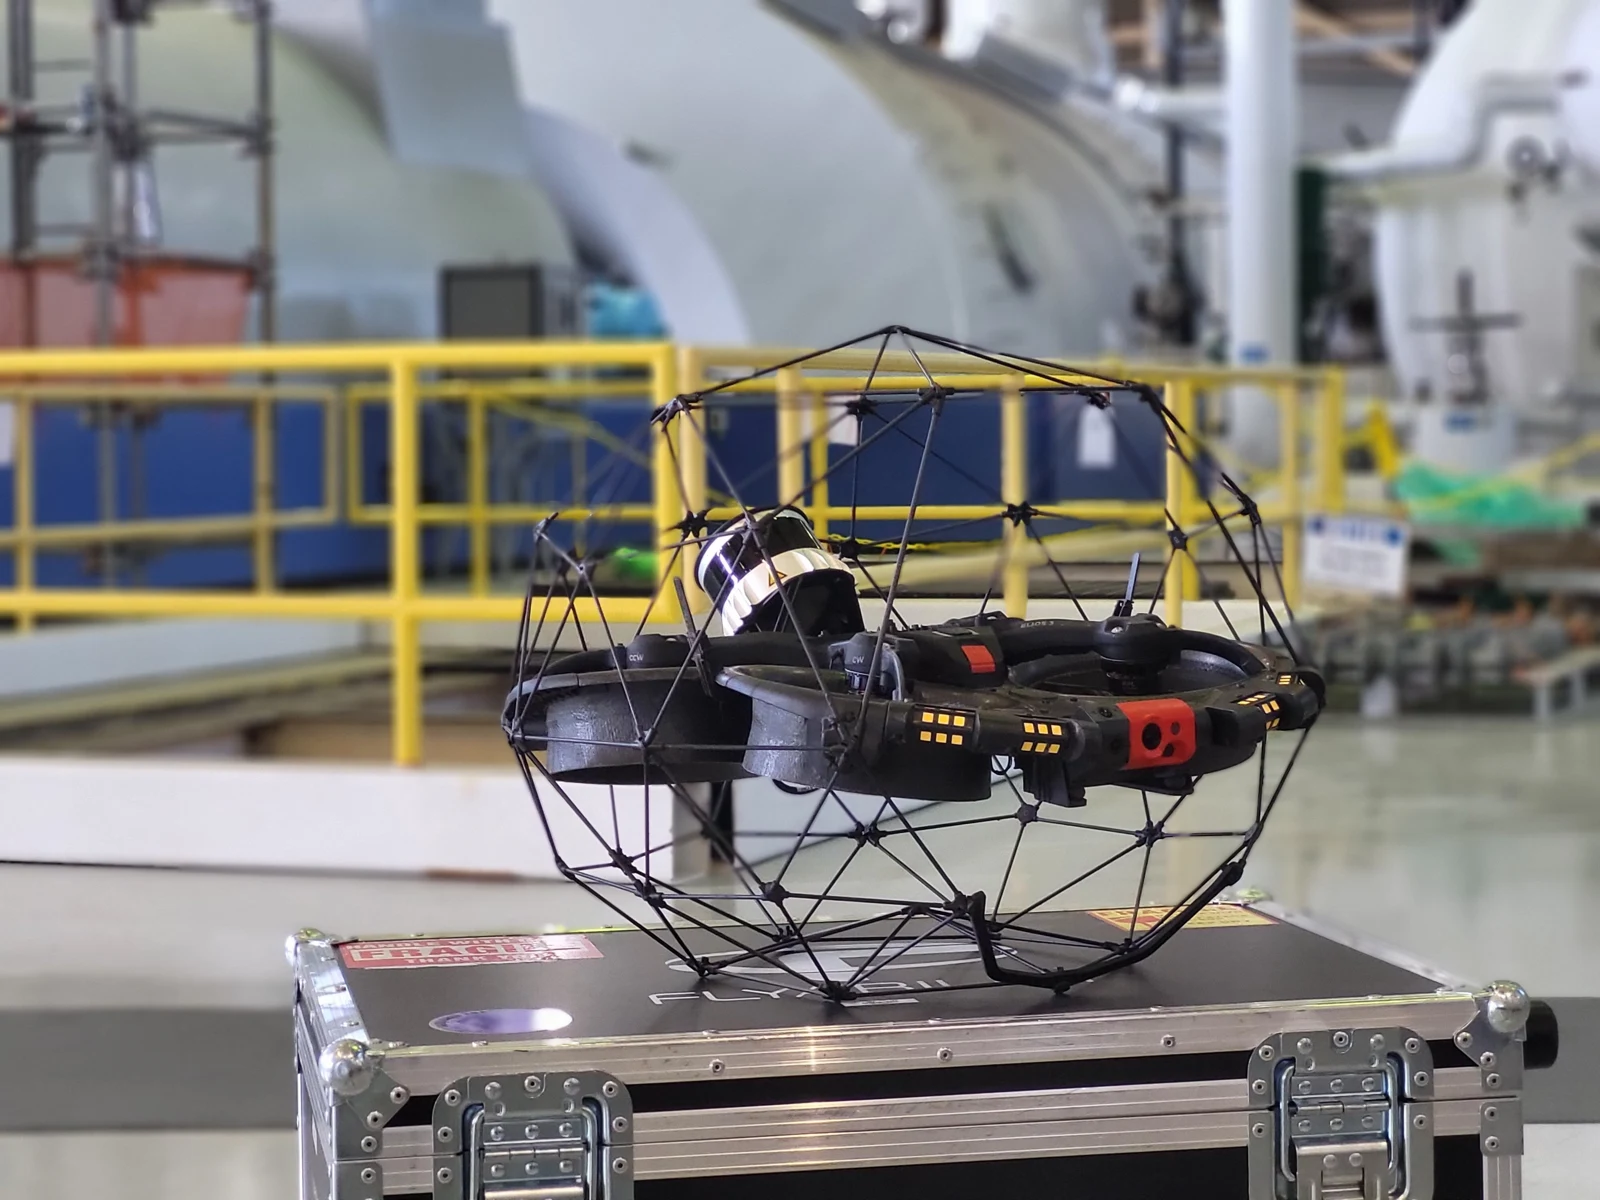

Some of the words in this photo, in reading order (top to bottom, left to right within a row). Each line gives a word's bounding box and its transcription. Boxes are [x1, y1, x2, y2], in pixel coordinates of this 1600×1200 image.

[629, 653, 644, 662] CCW
[852, 656, 865, 664] CW
[346, 941, 440, 950] HANDLE
[448, 938, 511, 946] WITH
[404, 955, 488, 964] THANK
